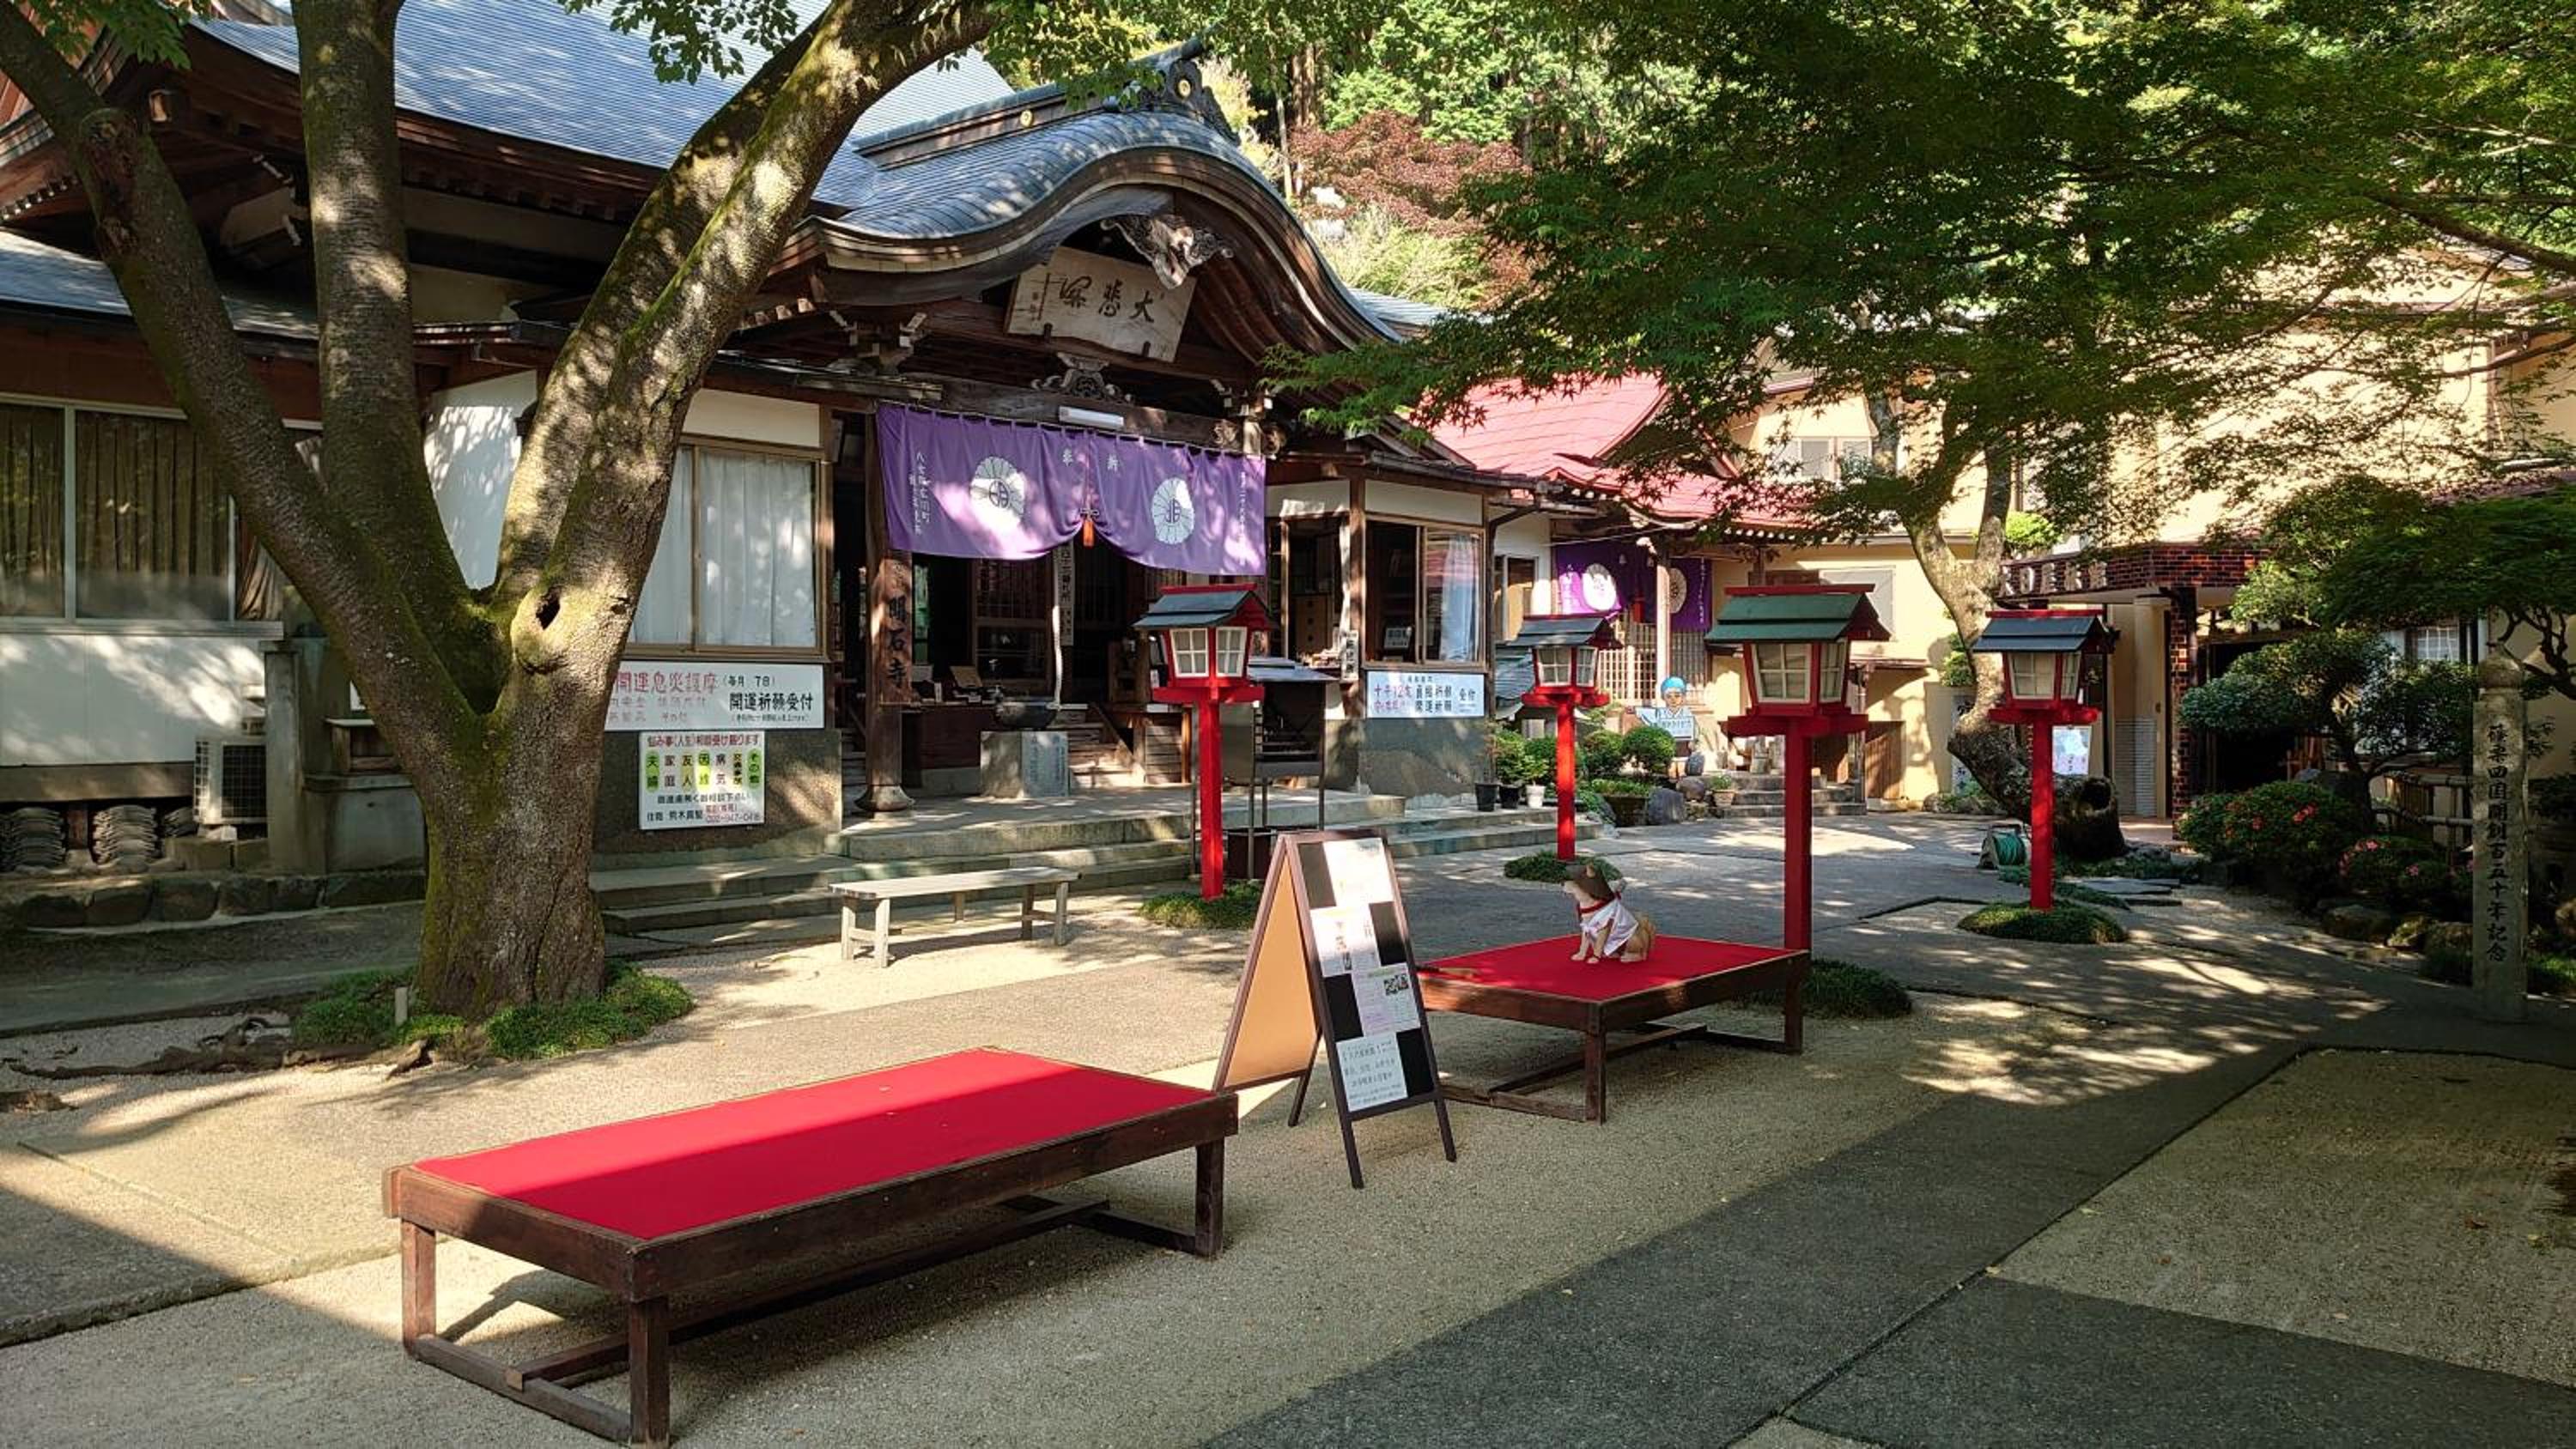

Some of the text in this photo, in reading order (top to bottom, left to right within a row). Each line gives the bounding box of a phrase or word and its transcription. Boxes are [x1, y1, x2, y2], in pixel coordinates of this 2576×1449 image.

[730, 693, 813, 712] 開運祈願受付
[665, 755, 676, 787] 家庭
[683, 755, 693, 786] 友人
[716, 754, 726, 785] 病気
[749, 753, 760, 785] その他
